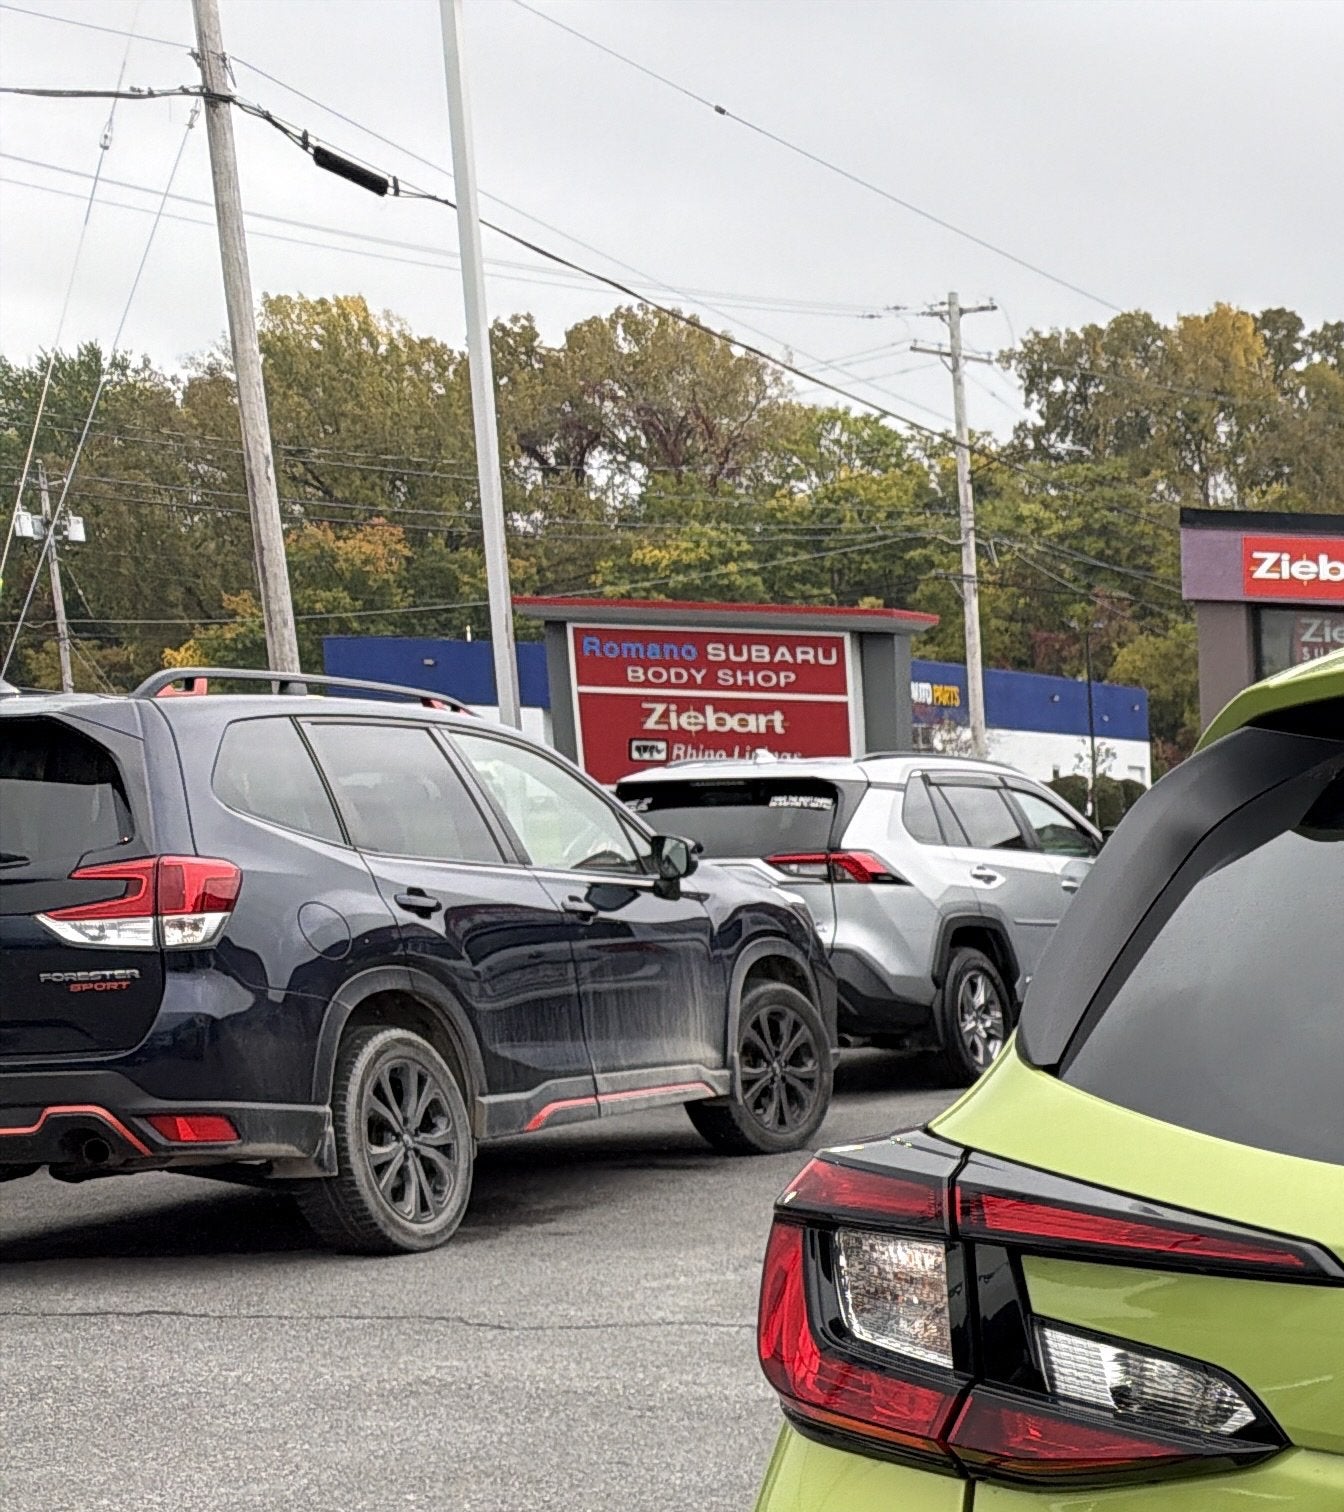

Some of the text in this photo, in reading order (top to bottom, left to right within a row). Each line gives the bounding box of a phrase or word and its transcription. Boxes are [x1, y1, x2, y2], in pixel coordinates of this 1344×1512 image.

[581, 634, 838, 666] Romano SUBARU
[626, 665, 797, 688] BODY SHOP
[933, 683, 960, 708] PARTS
[640, 702, 787, 735] Ziebart
[672, 742, 728, 761] Rhino
[39, 968, 141, 983] FORESTER
[69, 980, 131, 993] SPORT
